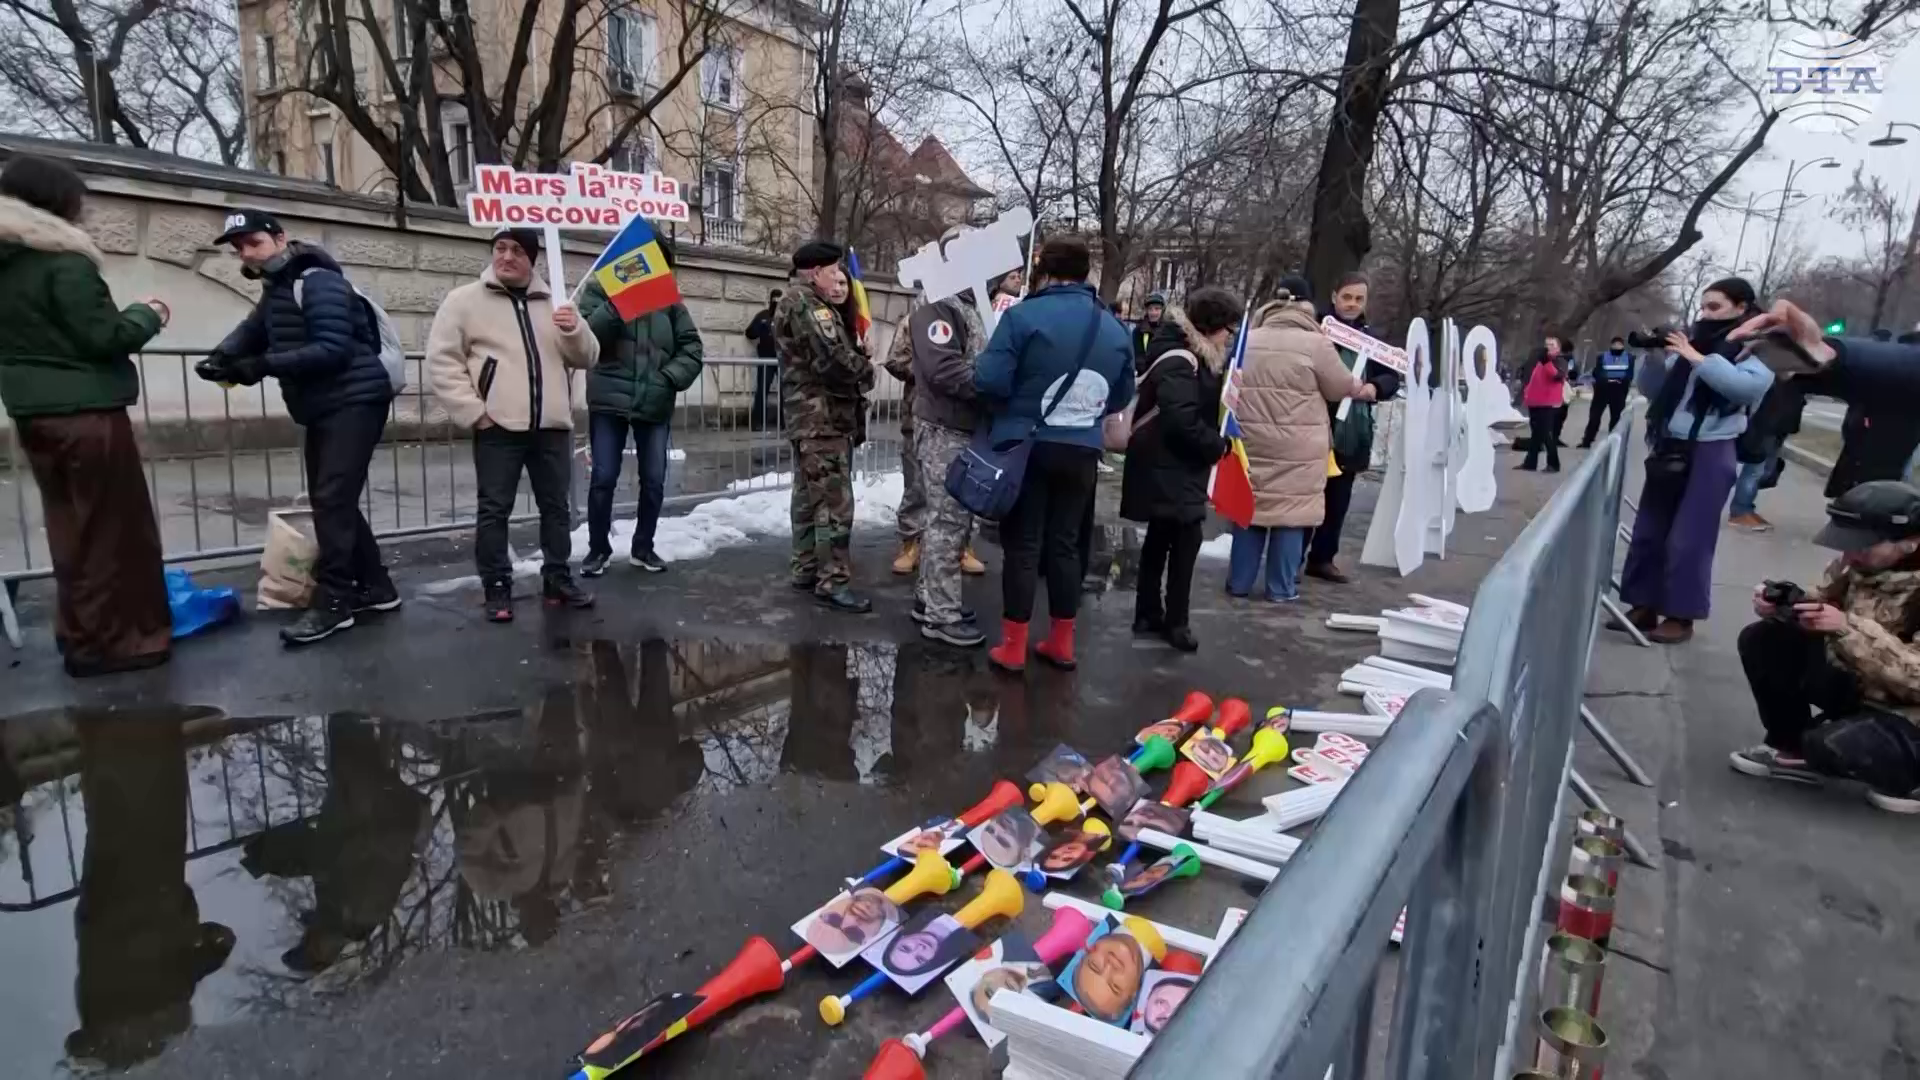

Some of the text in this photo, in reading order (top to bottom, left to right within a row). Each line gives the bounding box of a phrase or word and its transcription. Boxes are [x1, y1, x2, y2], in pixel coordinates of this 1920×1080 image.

[481, 169, 607, 204] Marș la
[653, 174, 676, 195] la
[472, 197, 620, 226] Moscova
